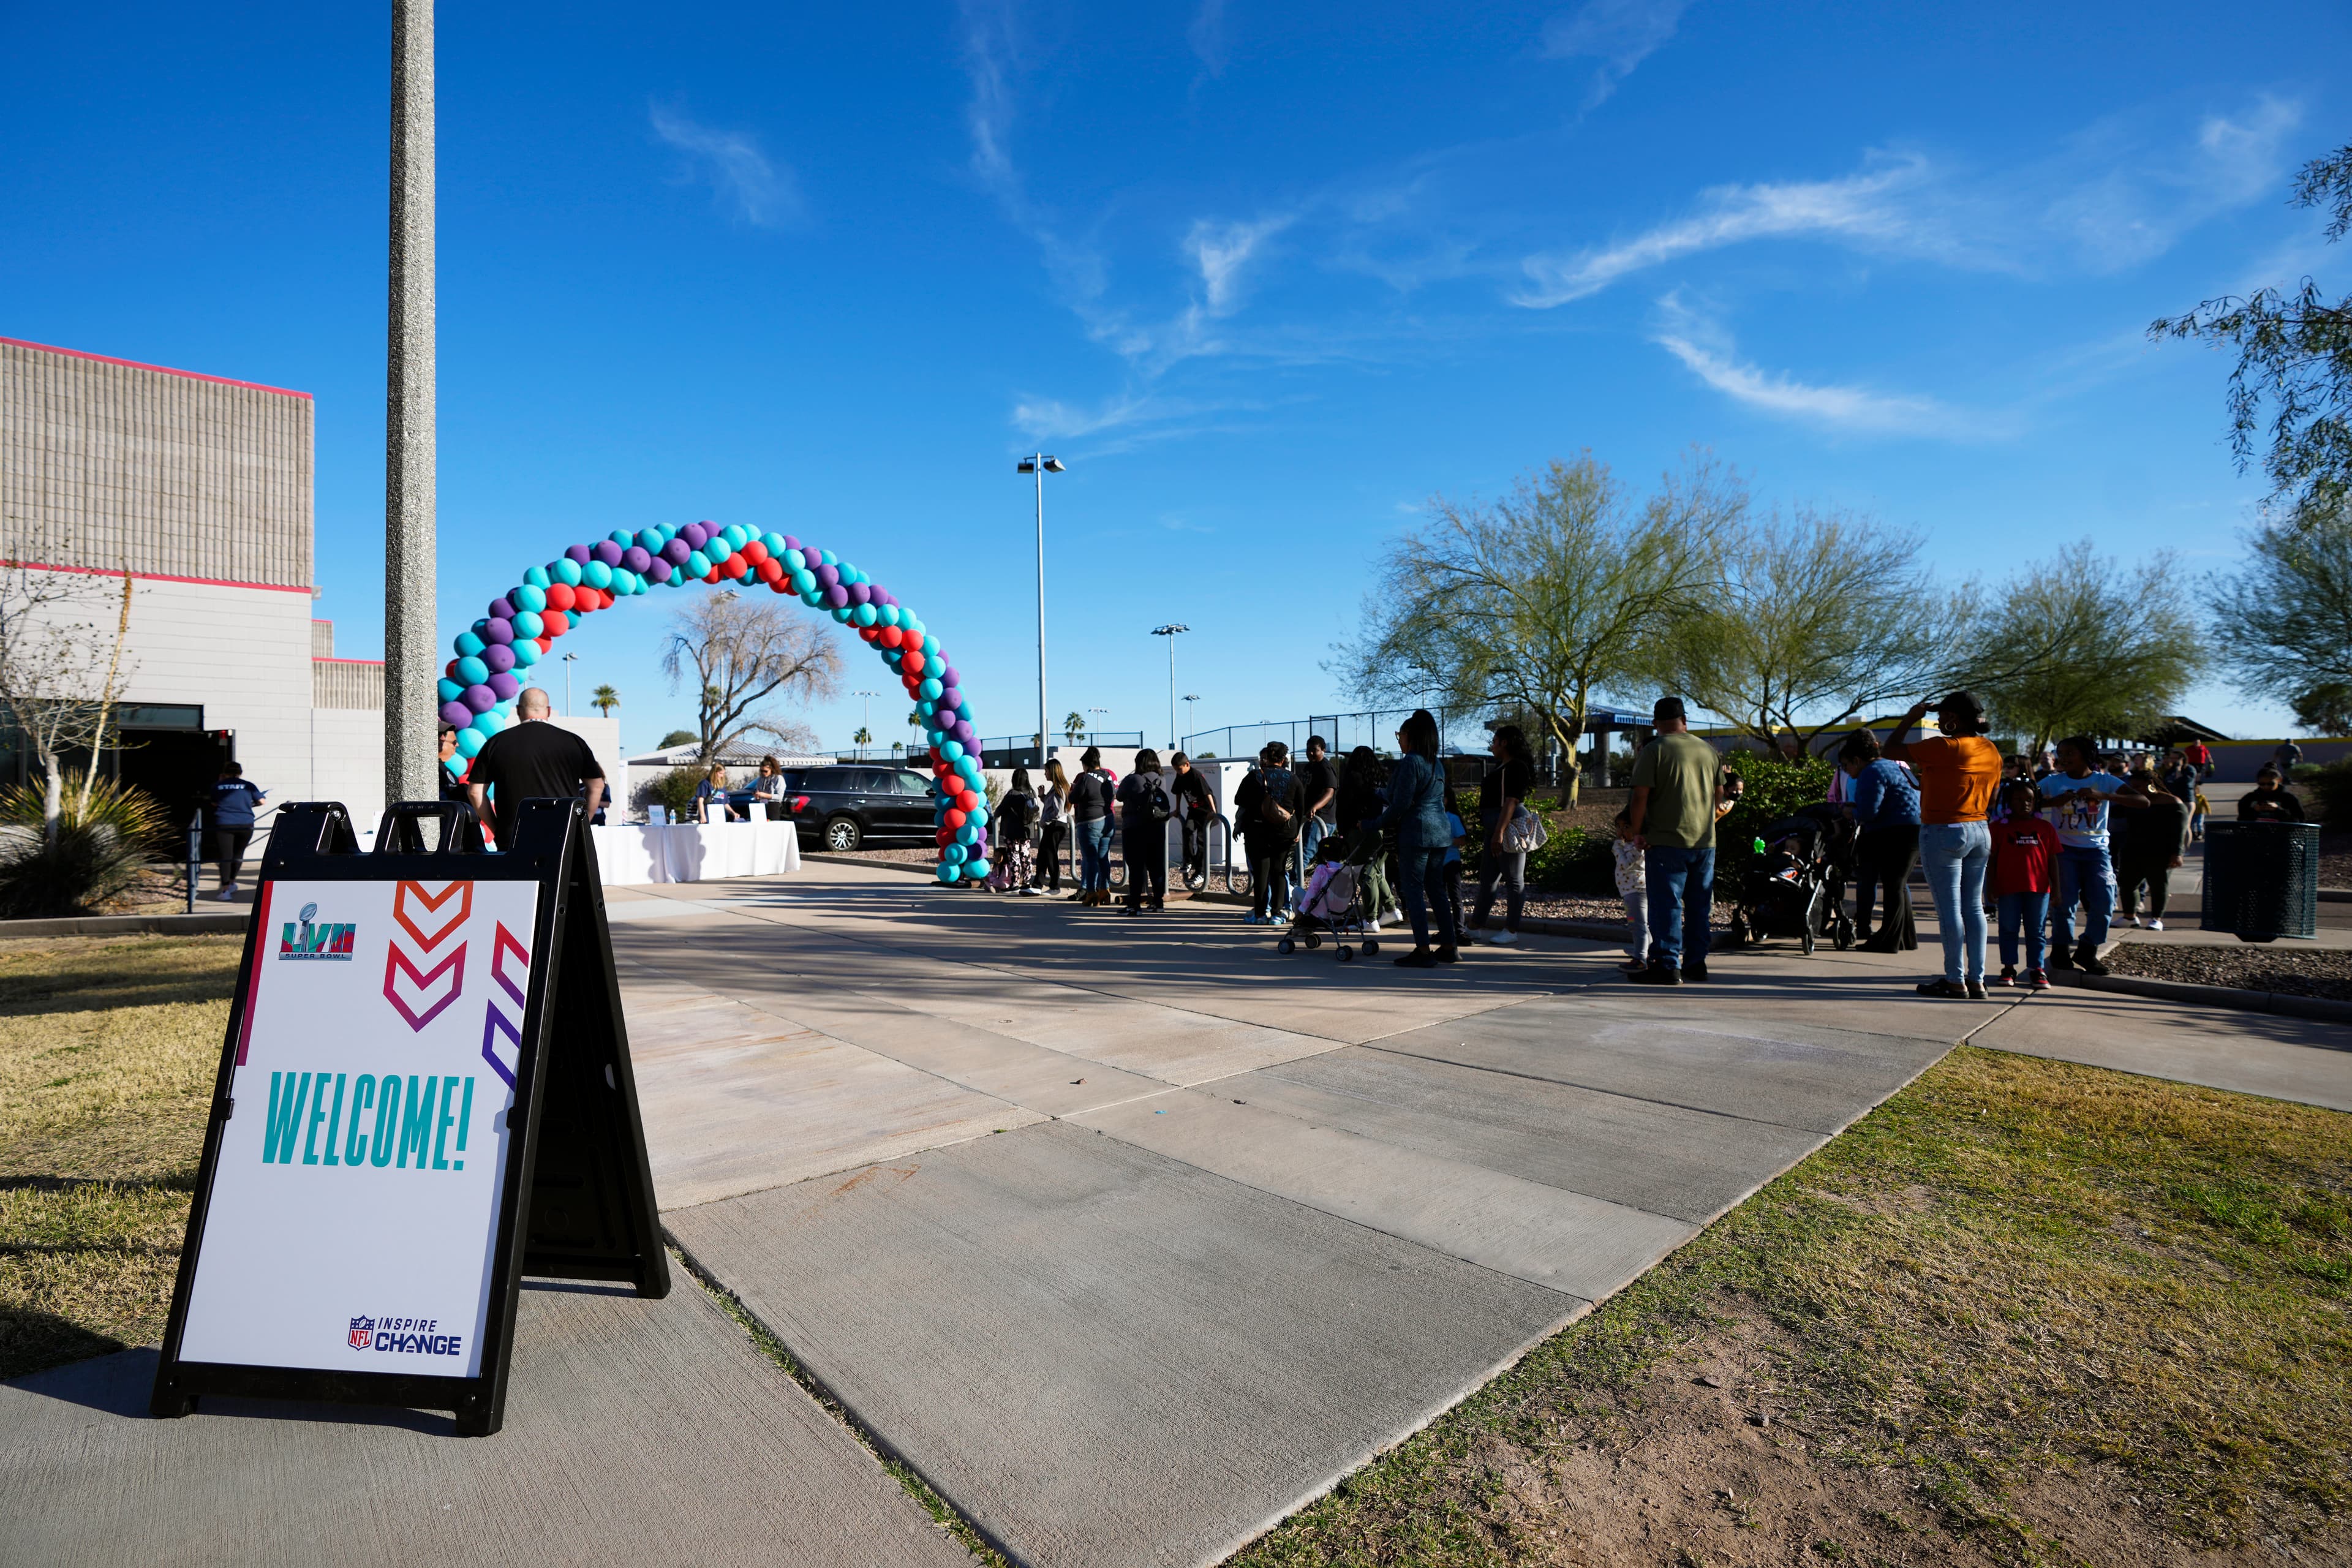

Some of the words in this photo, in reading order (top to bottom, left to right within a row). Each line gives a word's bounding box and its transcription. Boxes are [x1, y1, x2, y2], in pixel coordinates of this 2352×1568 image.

[281, 922, 356, 952] LVII
[262, 1071, 475, 1170] WELCOME!
[377, 1317, 437, 1332] INSPIRE
[350, 1330, 370, 1348] NFL
[375, 1332, 462, 1356] CHANGE
